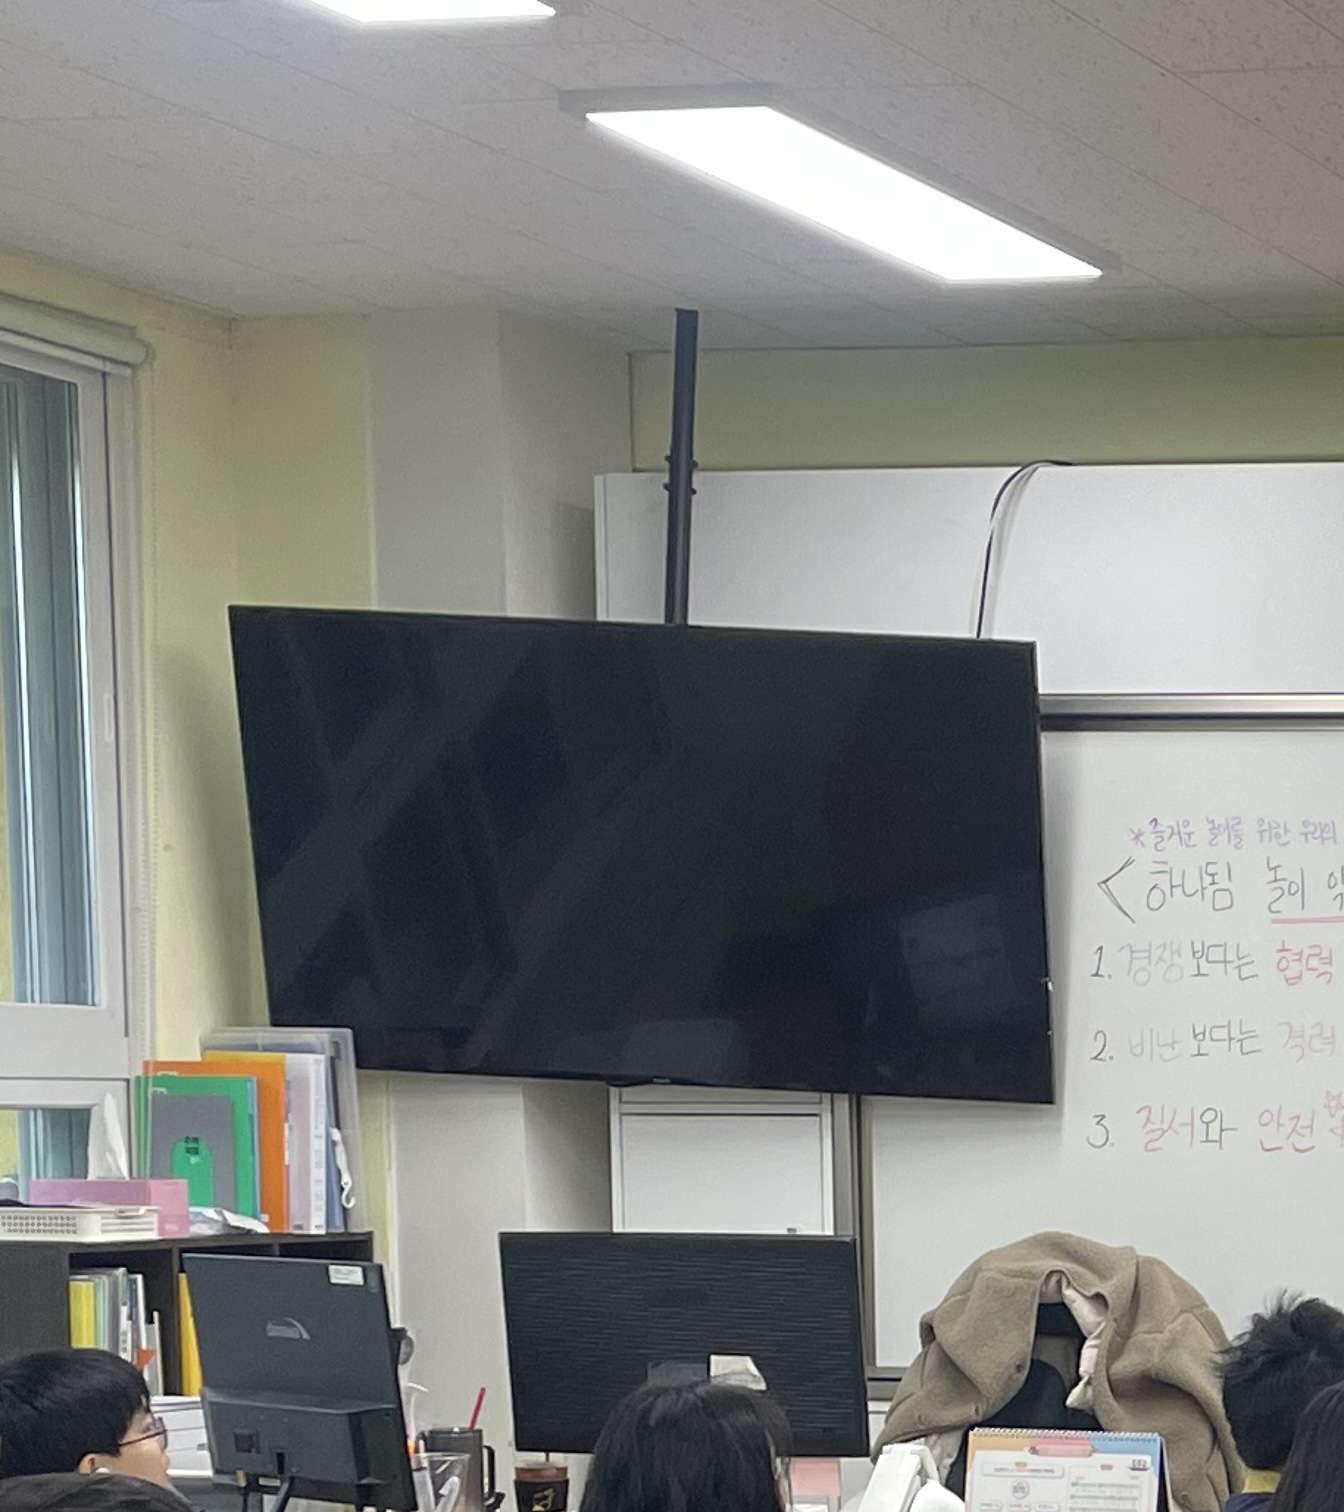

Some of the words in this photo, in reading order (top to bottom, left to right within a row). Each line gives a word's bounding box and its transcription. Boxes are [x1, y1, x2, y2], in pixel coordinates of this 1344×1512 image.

[1267, 856, 1305, 913] 놀이
[1090, 945, 1112, 980] 1.
[1276, 940, 1333, 986] 협력
[1090, 1030, 1114, 1061] 2.
[1087, 1114, 1114, 1149] 3.
[1136, 1104, 1238, 1154] 질서와
[1259, 1104, 1316, 1154] 안전
